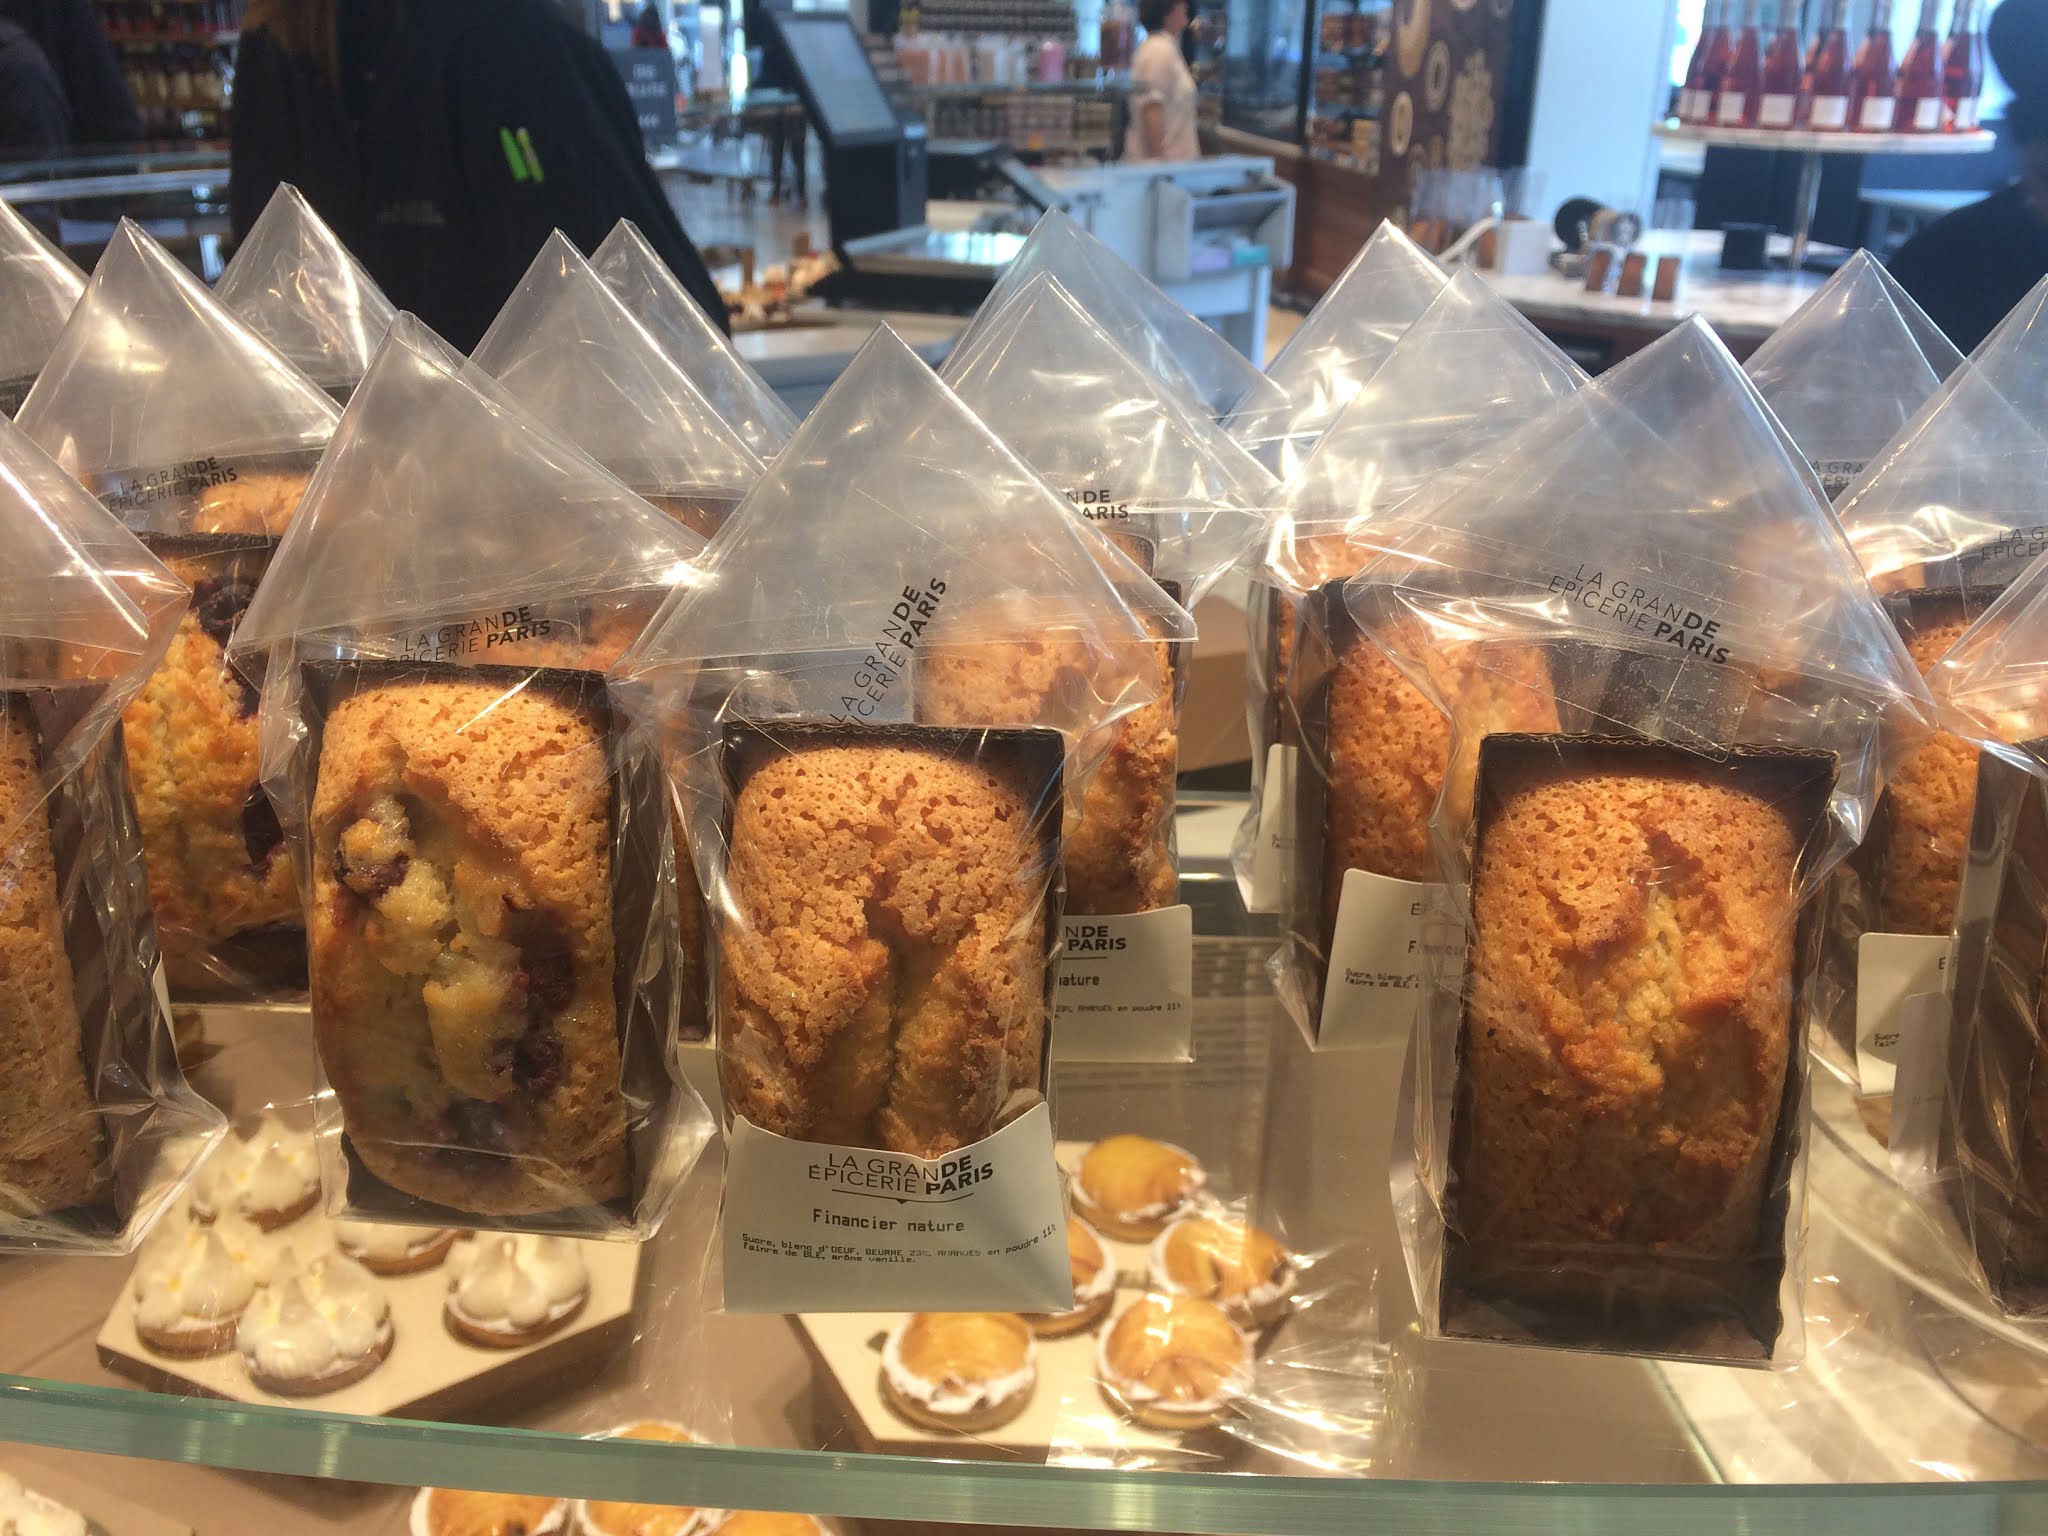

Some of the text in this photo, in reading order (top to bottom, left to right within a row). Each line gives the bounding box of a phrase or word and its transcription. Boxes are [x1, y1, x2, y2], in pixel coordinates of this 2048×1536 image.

[120, 456, 220, 497] LA GRANDE
[187, 467, 239, 493] PARIS
[1082, 504, 1129, 521] ARIS
[899, 577, 947, 650] PARIS
[1574, 564, 1721, 640] LA GRANDE
[404, 605, 533, 652] LA GRANDE
[486, 619, 551, 649] PARIS
[1547, 575, 1731, 665] EPICERIE PARIS
[829, 584, 921, 723] LA GRANDE
[1067, 937, 1127, 951] PARIS
[1131, 1003, 1162, 1012] poudre
[807, 1162, 994, 1195] ÉPICERIE PARIS
[828, 1152, 973, 1182] LA GRANDE
[812, 1207, 965, 1232] Financier nature
[742, 1232, 776, 1248] Sucre,
[781, 1240, 813, 1251] blanc
[865, 1247, 903, 1256] BEURRE
[1005, 1236, 1039, 1254] poudre
[1042, 1223, 1057, 1239] 11%
[785, 1249, 798, 1257] de
[868, 1255, 916, 1263] vanille.
